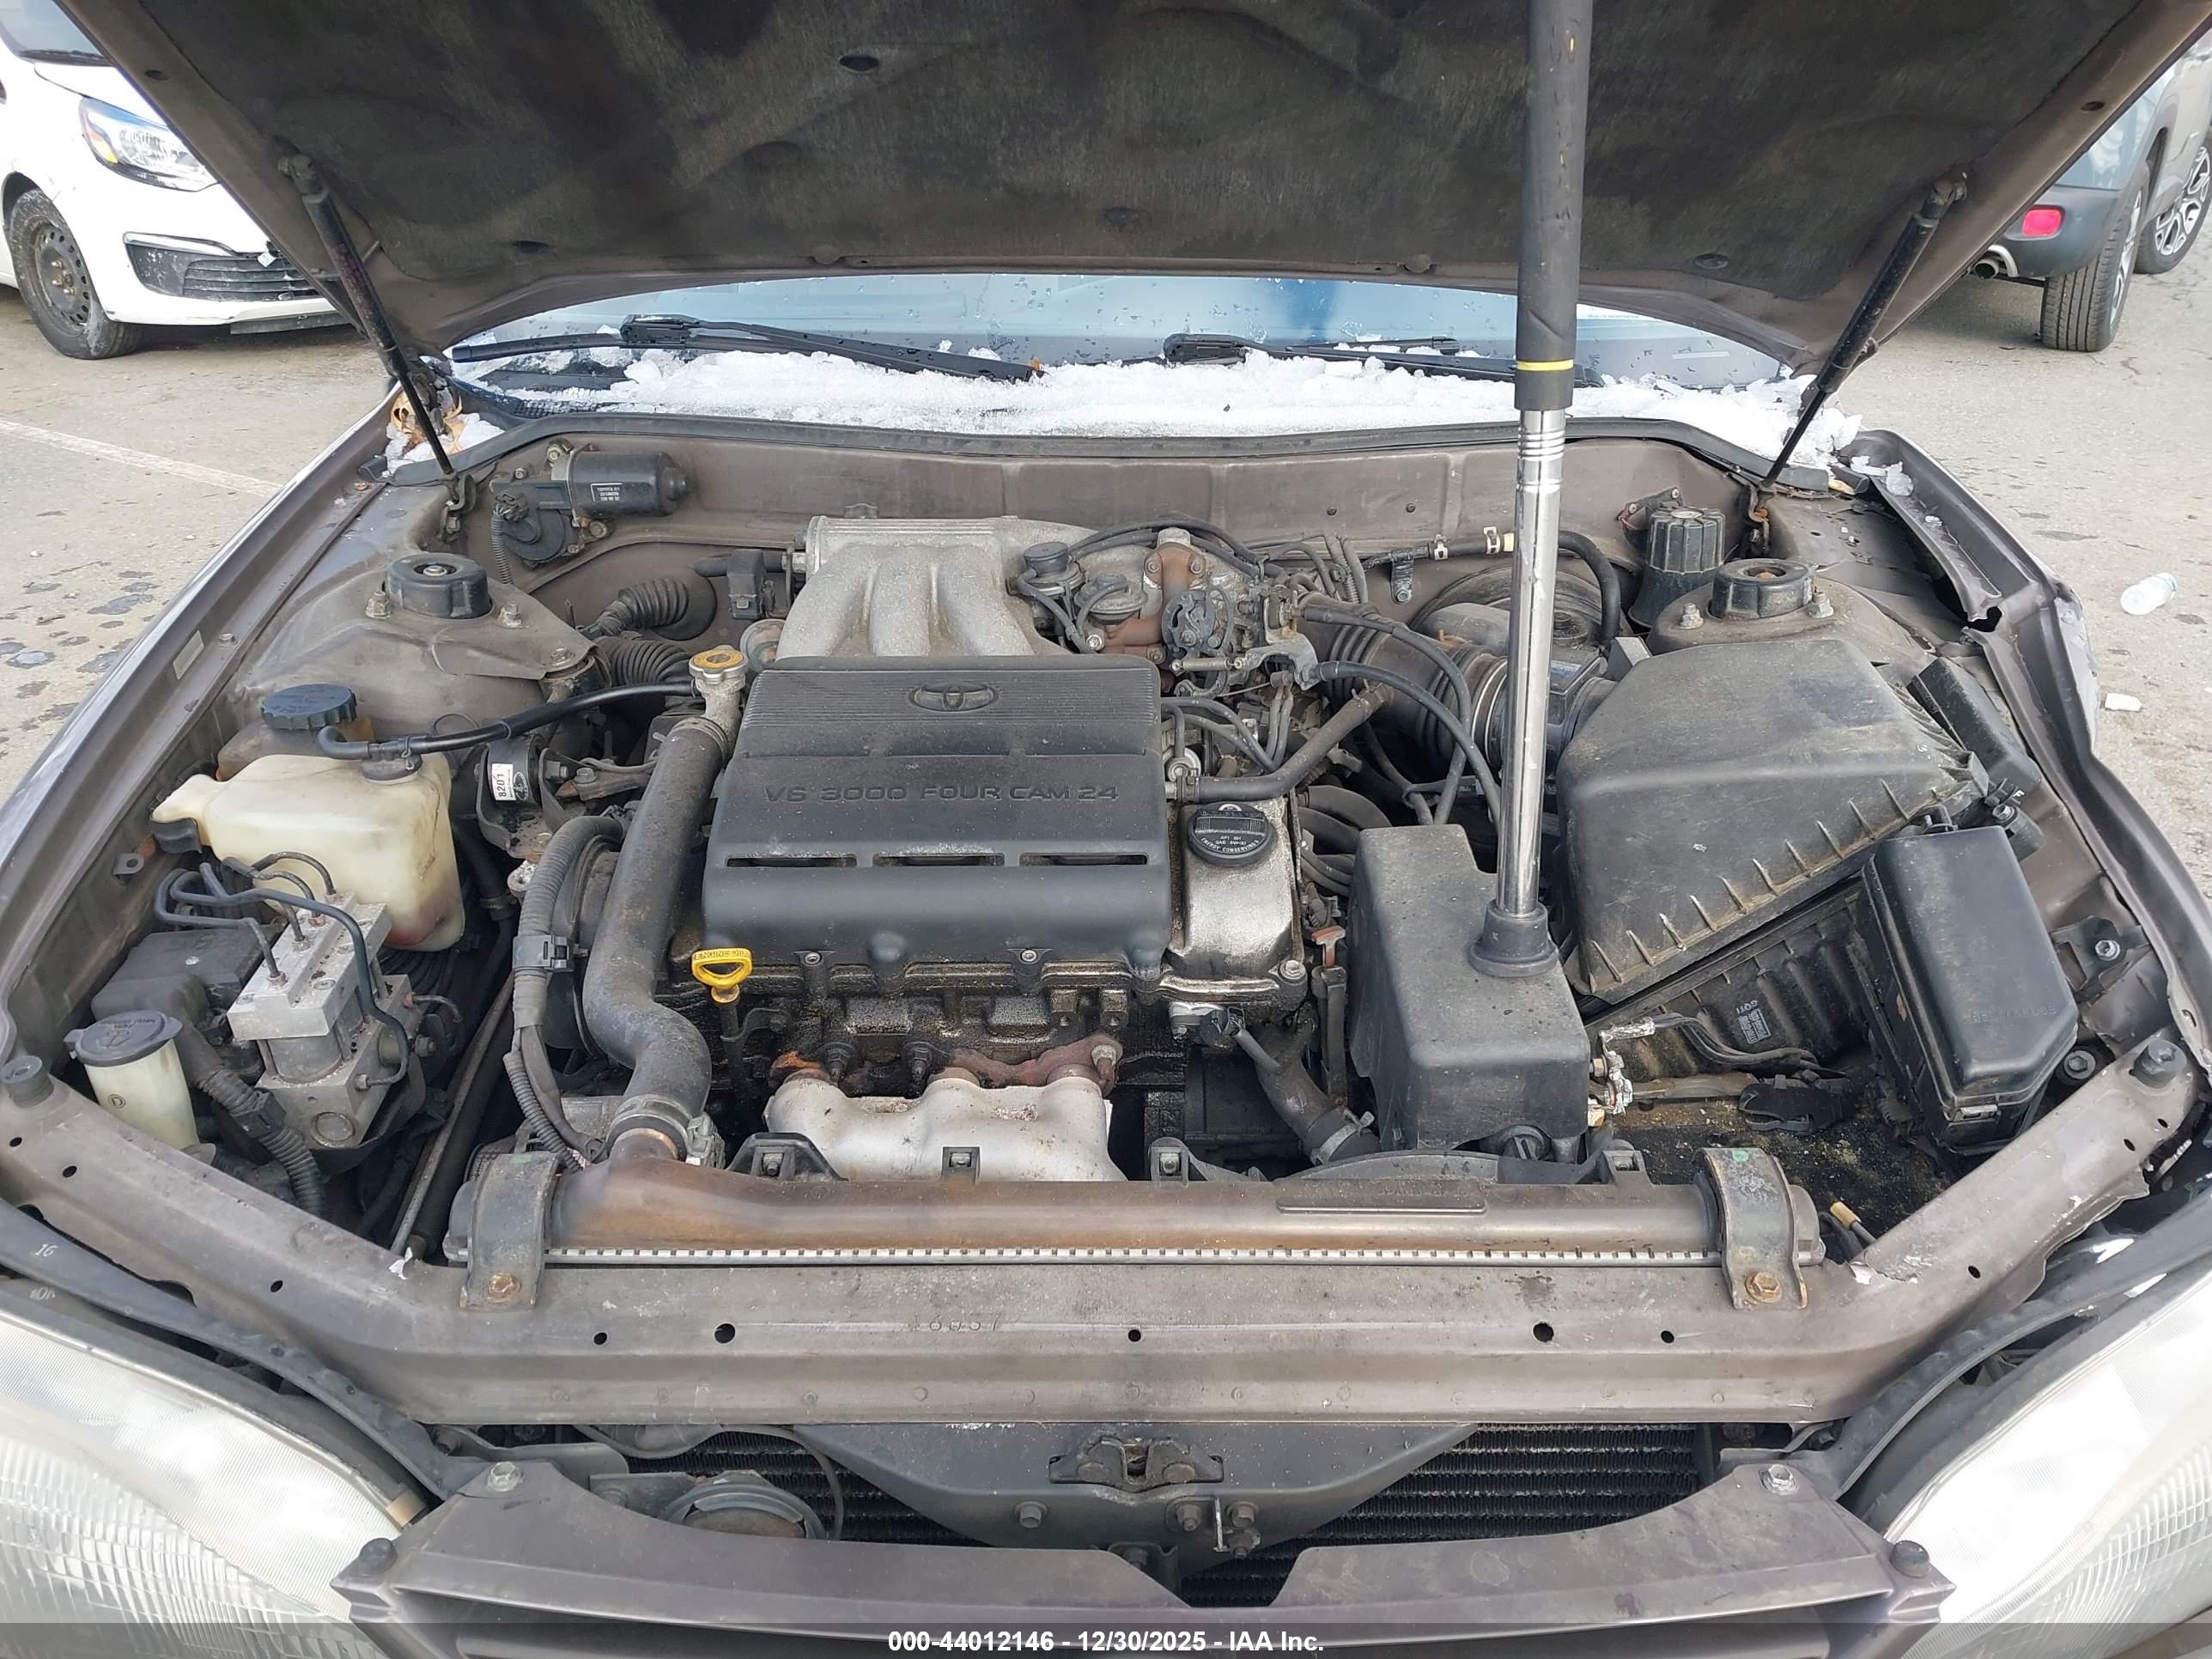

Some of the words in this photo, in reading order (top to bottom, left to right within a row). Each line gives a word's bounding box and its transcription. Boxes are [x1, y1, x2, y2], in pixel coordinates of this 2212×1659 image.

[496, 774, 507, 797] 8201
[763, 786, 806, 802] V6
[818, 786, 908, 801] 3000
[920, 785, 1002, 800] FOUR
[1008, 785, 1071, 800] CAM
[1077, 785, 1119, 801] 24
[695, 951, 729, 960] ENGINE
[34, 1243, 58, 1257] 16
